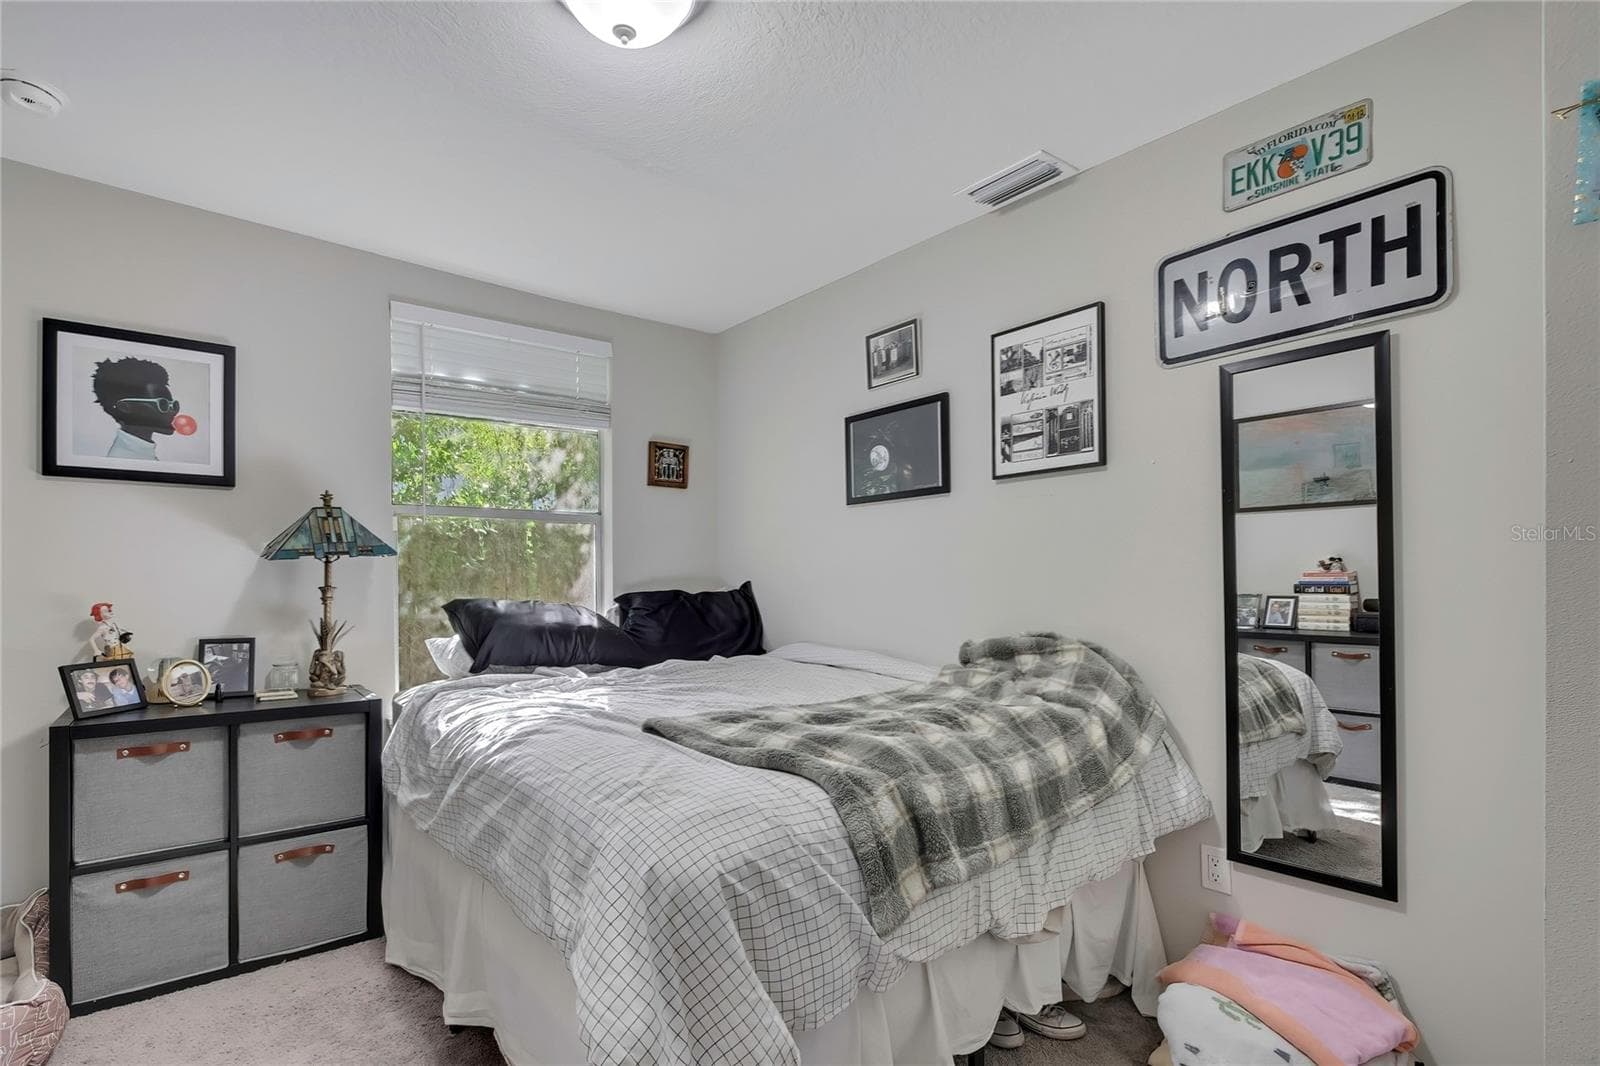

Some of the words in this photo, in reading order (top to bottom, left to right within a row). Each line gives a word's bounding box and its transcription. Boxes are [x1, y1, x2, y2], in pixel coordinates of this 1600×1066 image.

[1231, 152, 1277, 196] EKK
[1311, 121, 1363, 166] V39
[1254, 178, 1300, 199] SUNSHINE
[1304, 162, 1336, 182] STATE
[1173, 203, 1422, 339] NORTH
